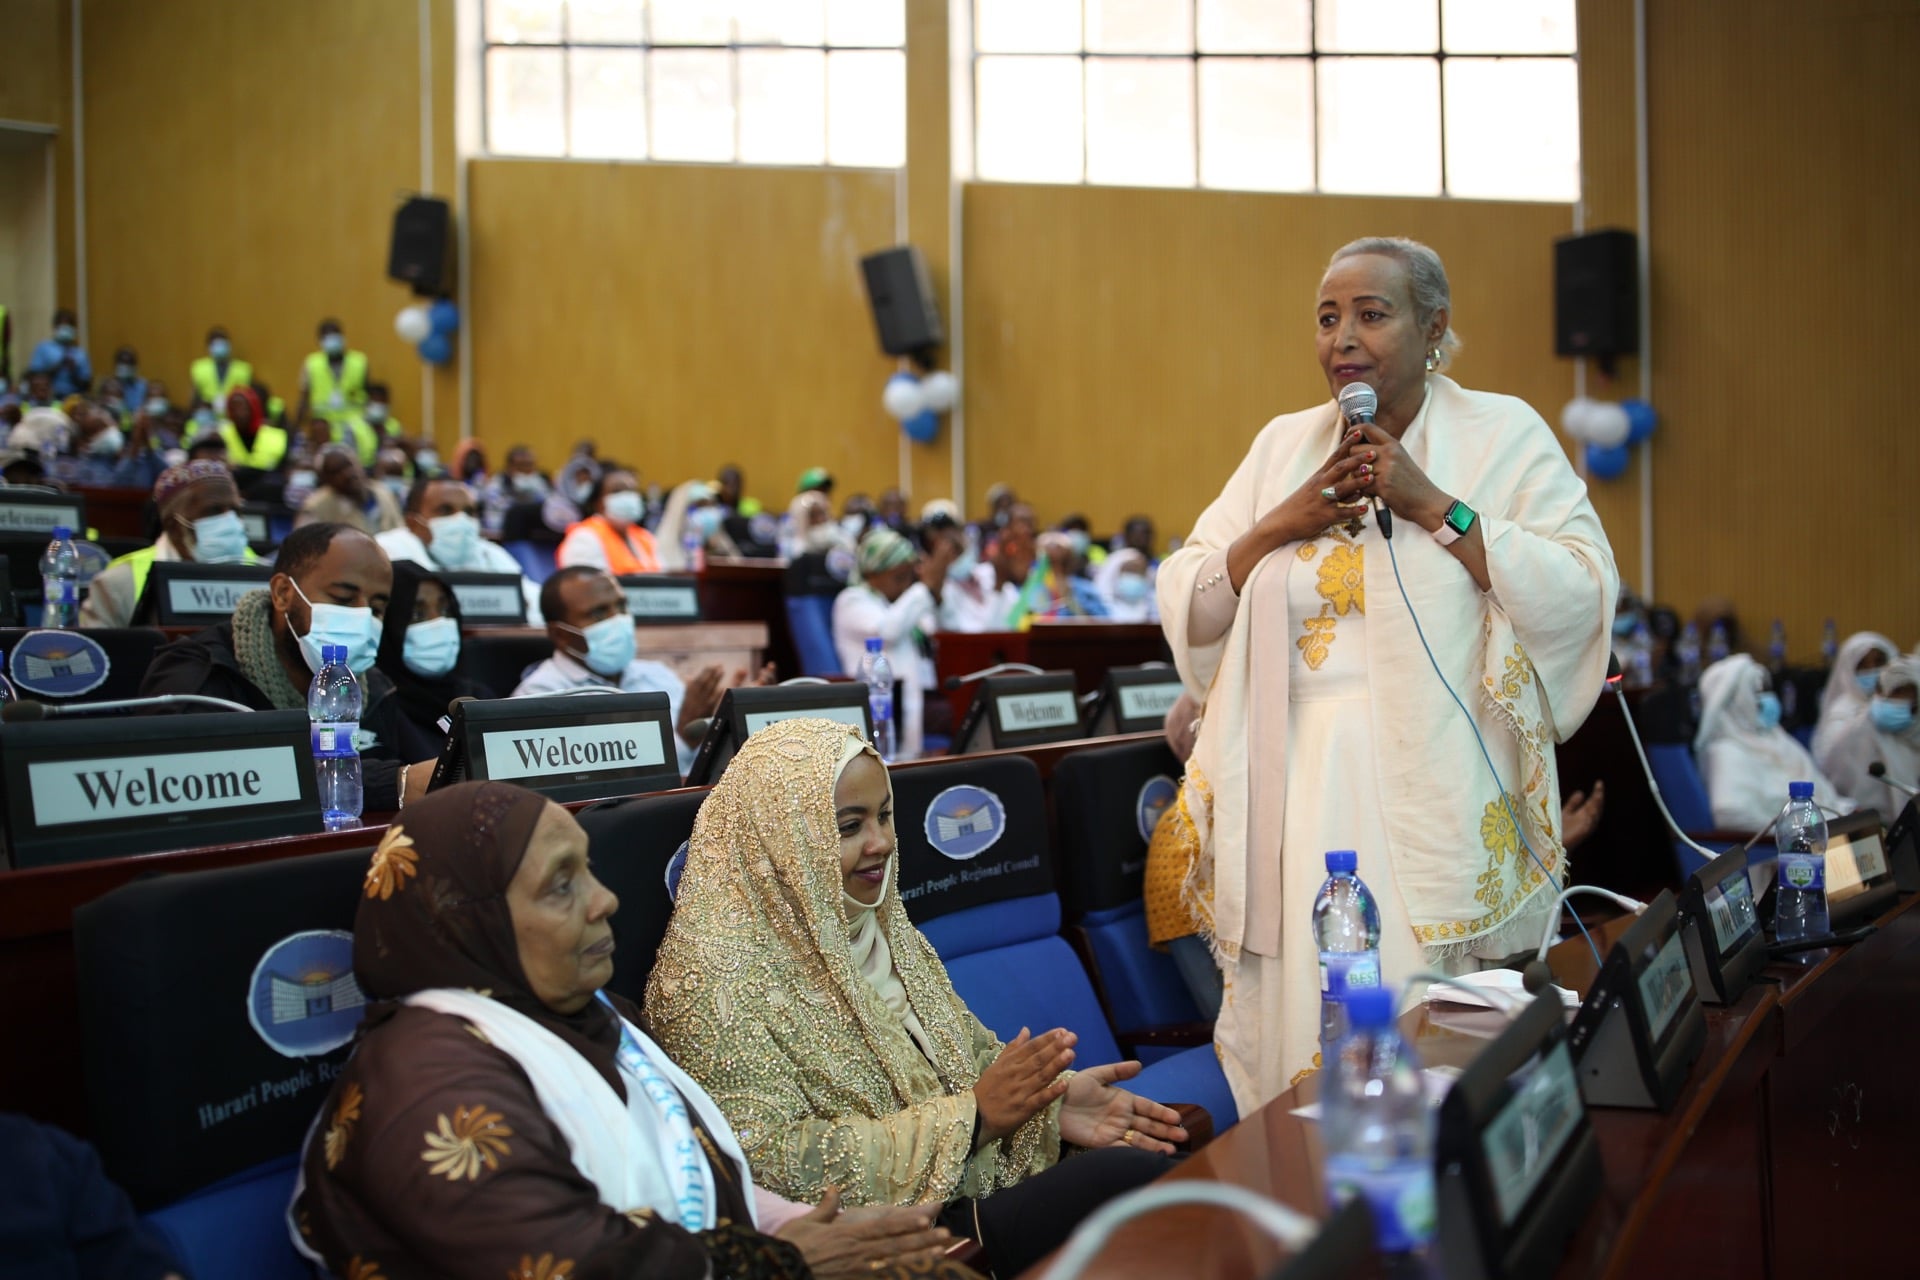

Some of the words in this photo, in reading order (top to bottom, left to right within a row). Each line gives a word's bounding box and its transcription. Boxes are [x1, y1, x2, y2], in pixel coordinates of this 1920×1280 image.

[0, 508, 59, 525] elcome
[190, 585, 241, 608] Welc
[1010, 700, 1065, 723] Welcome
[512, 736, 638, 770] Welcome
[75, 767, 262, 811] Welcome
[900, 883, 925, 901] arari
[926, 873, 959, 893] People
[961, 862, 1002, 882] Regional
[1003, 854, 1040, 873] Council
[1787, 866, 1813, 878] BEST
[1349, 970, 1378, 985] BEST
[197, 1085, 258, 1130] Harari
[260, 1068, 314, 1104] People
